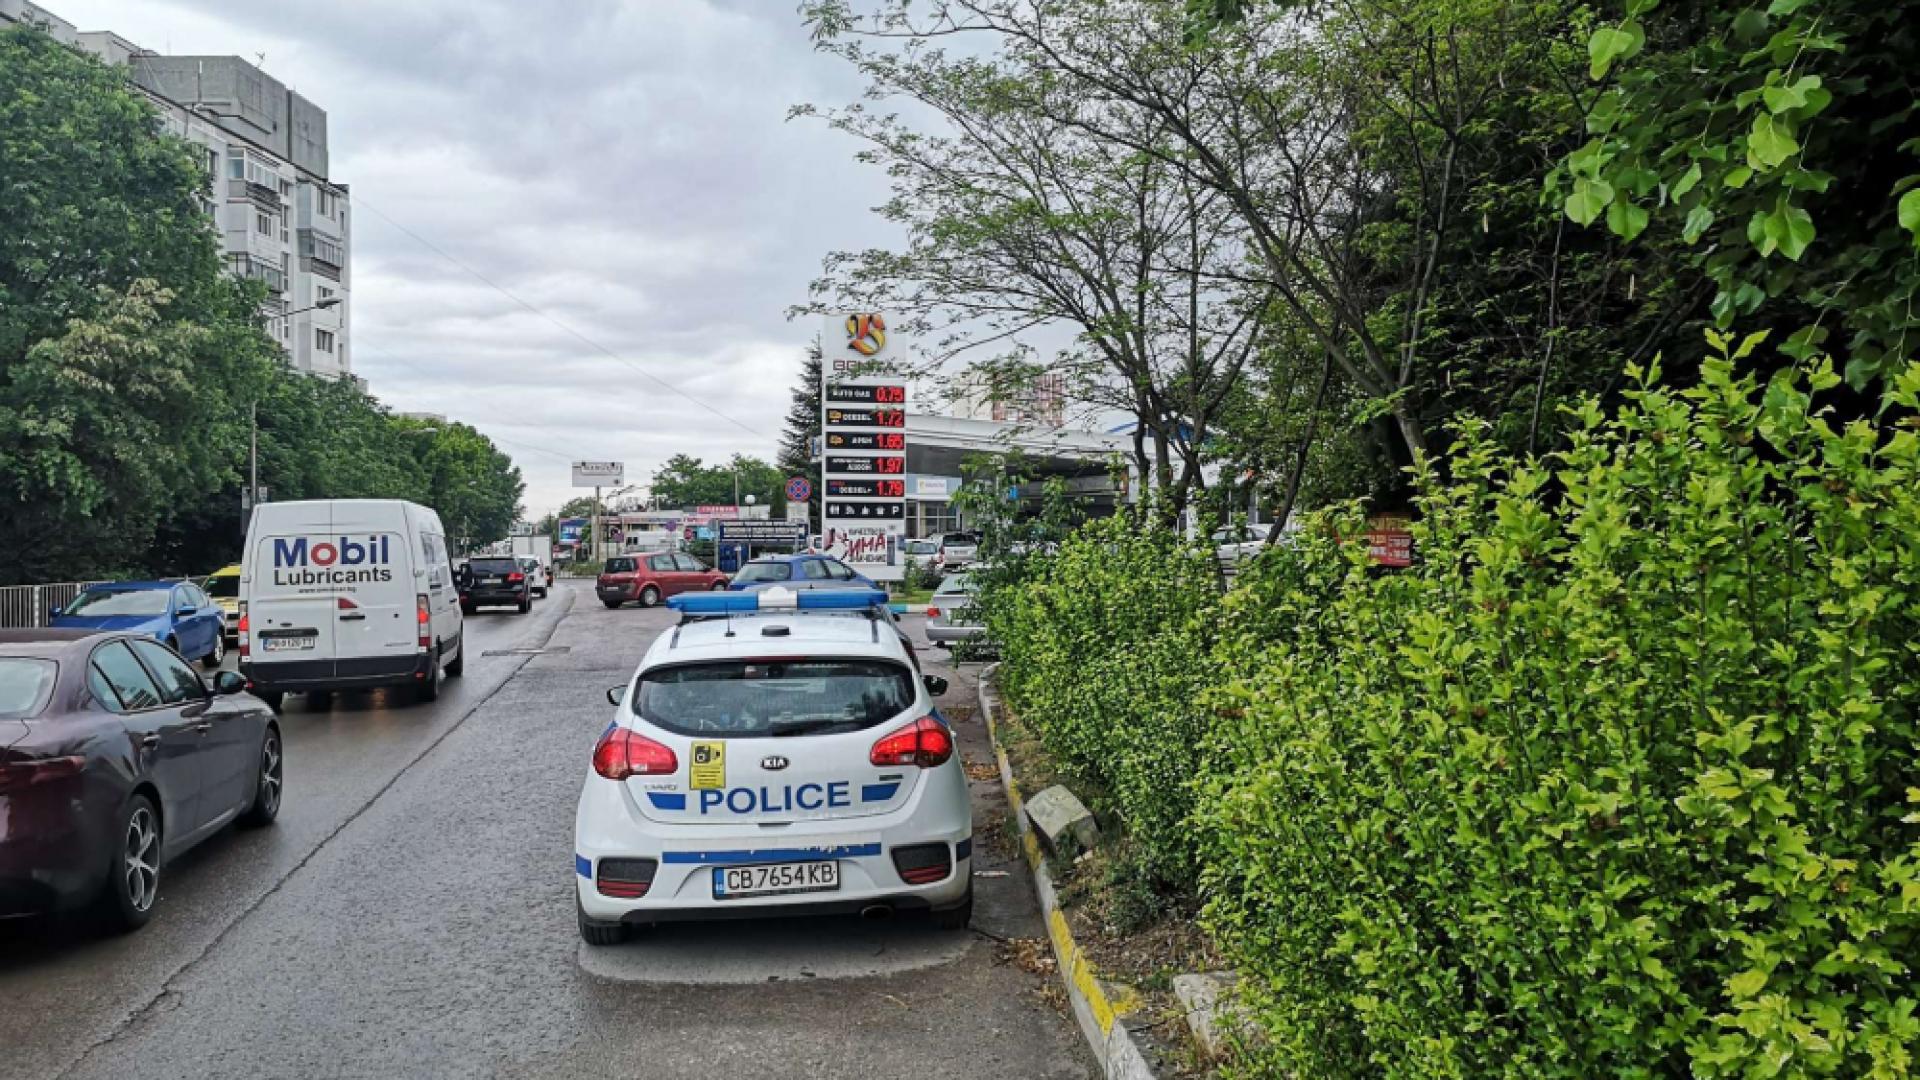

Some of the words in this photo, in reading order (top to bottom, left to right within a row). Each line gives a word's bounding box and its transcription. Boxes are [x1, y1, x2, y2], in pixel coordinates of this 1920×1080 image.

[876, 457, 904, 473] 1.97
[274, 535, 389, 568] Mobil
[274, 567, 392, 586] Lubricants
[763, 757, 788, 769] KIA
[700, 781, 851, 815] POLICE
